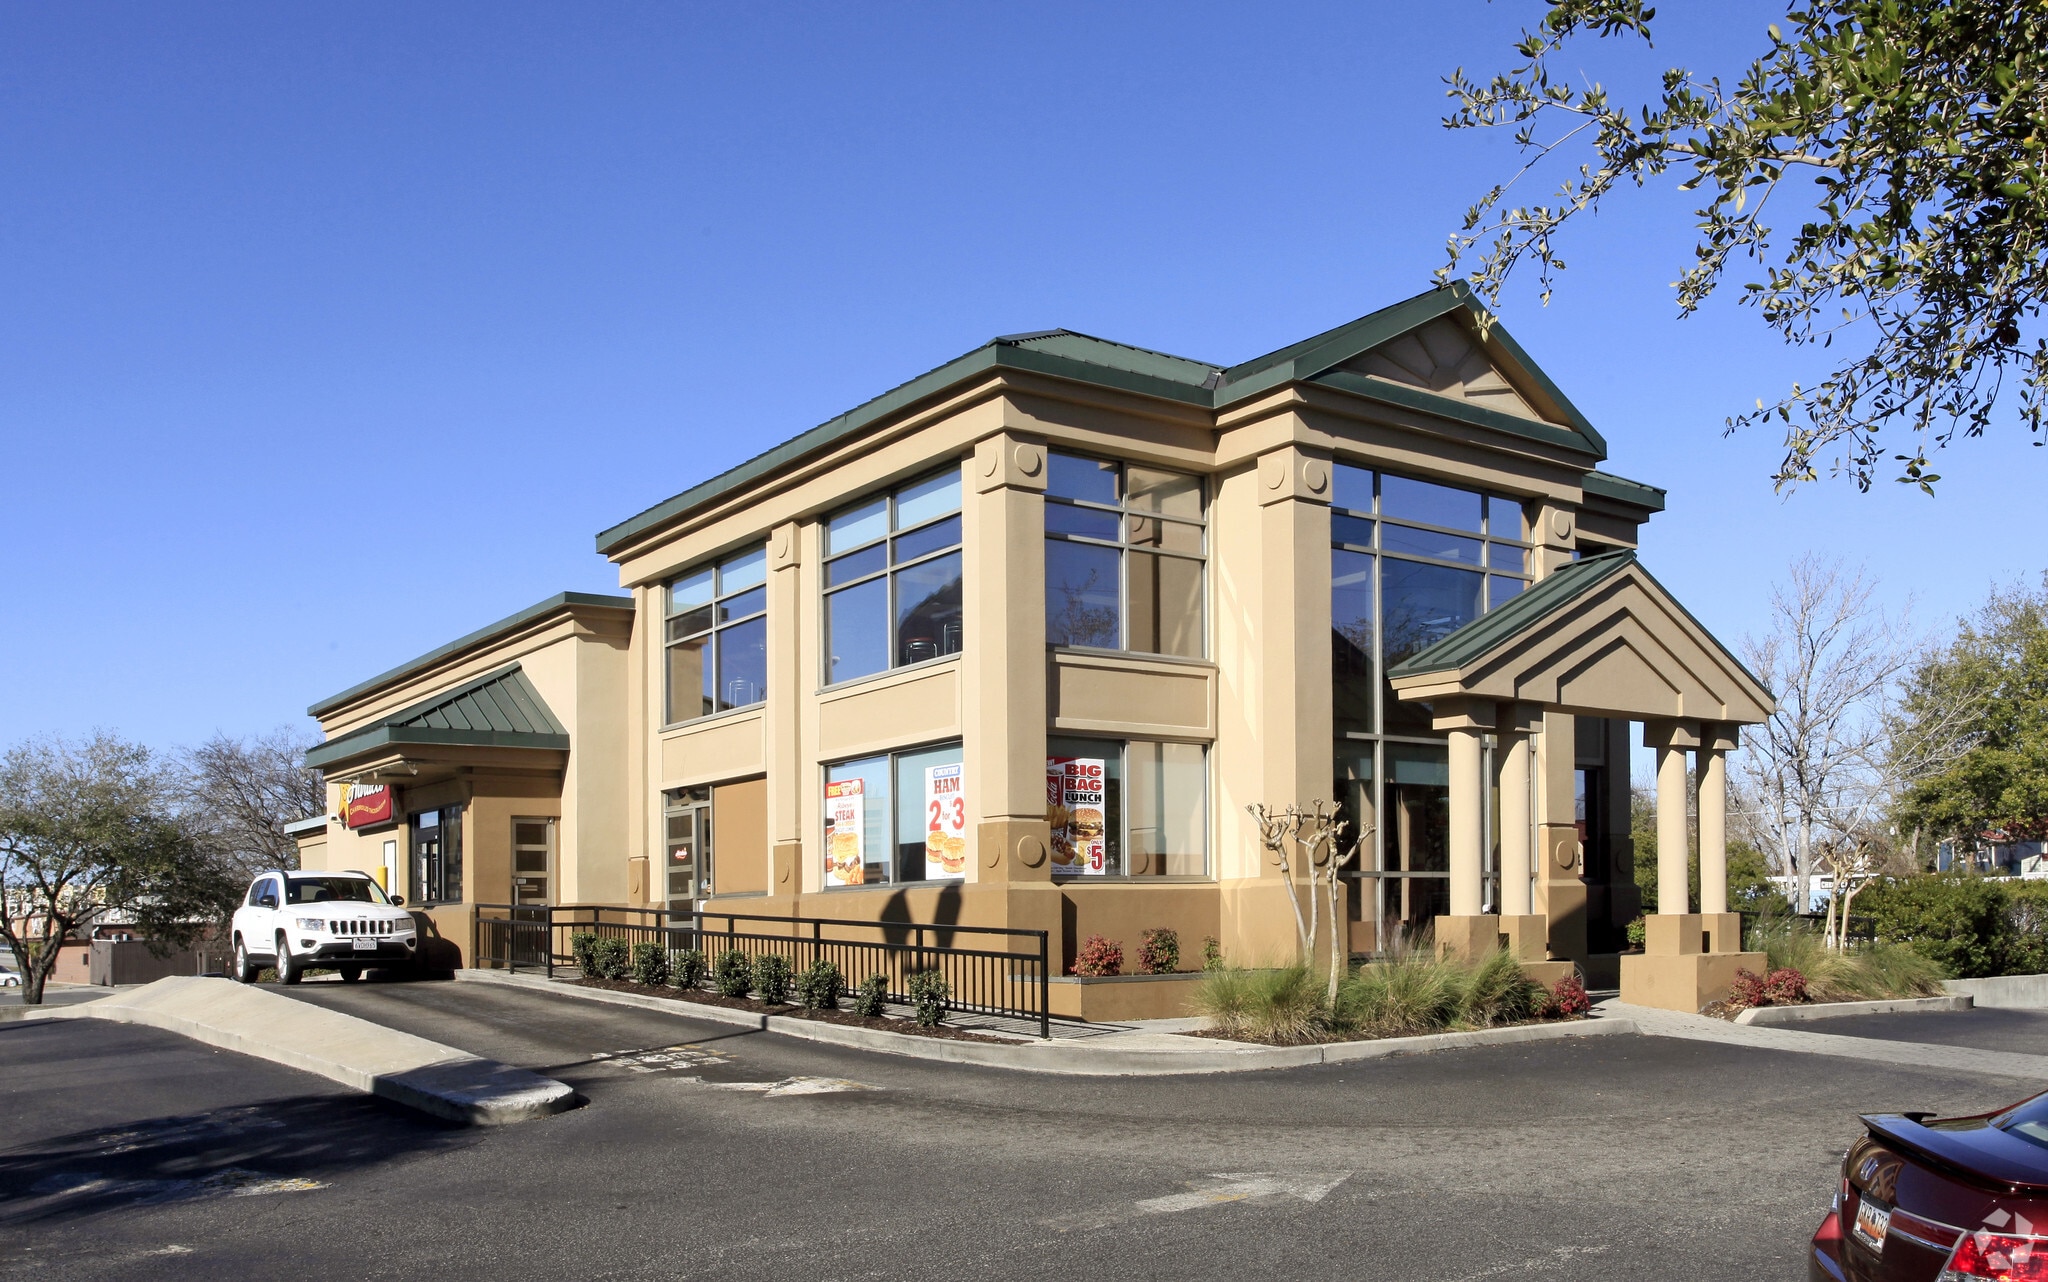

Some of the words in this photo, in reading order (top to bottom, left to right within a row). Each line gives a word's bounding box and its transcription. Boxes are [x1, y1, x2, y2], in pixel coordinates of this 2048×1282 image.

[1065, 764, 1101, 777] BIG
[934, 777, 960, 794] HAM
[1065, 778, 1102, 791] BAG
[1065, 793, 1102, 802] LUNCH
[835, 809, 855, 821] STEAK
[929, 800, 942, 831] 2
[942, 811, 951, 820] for
